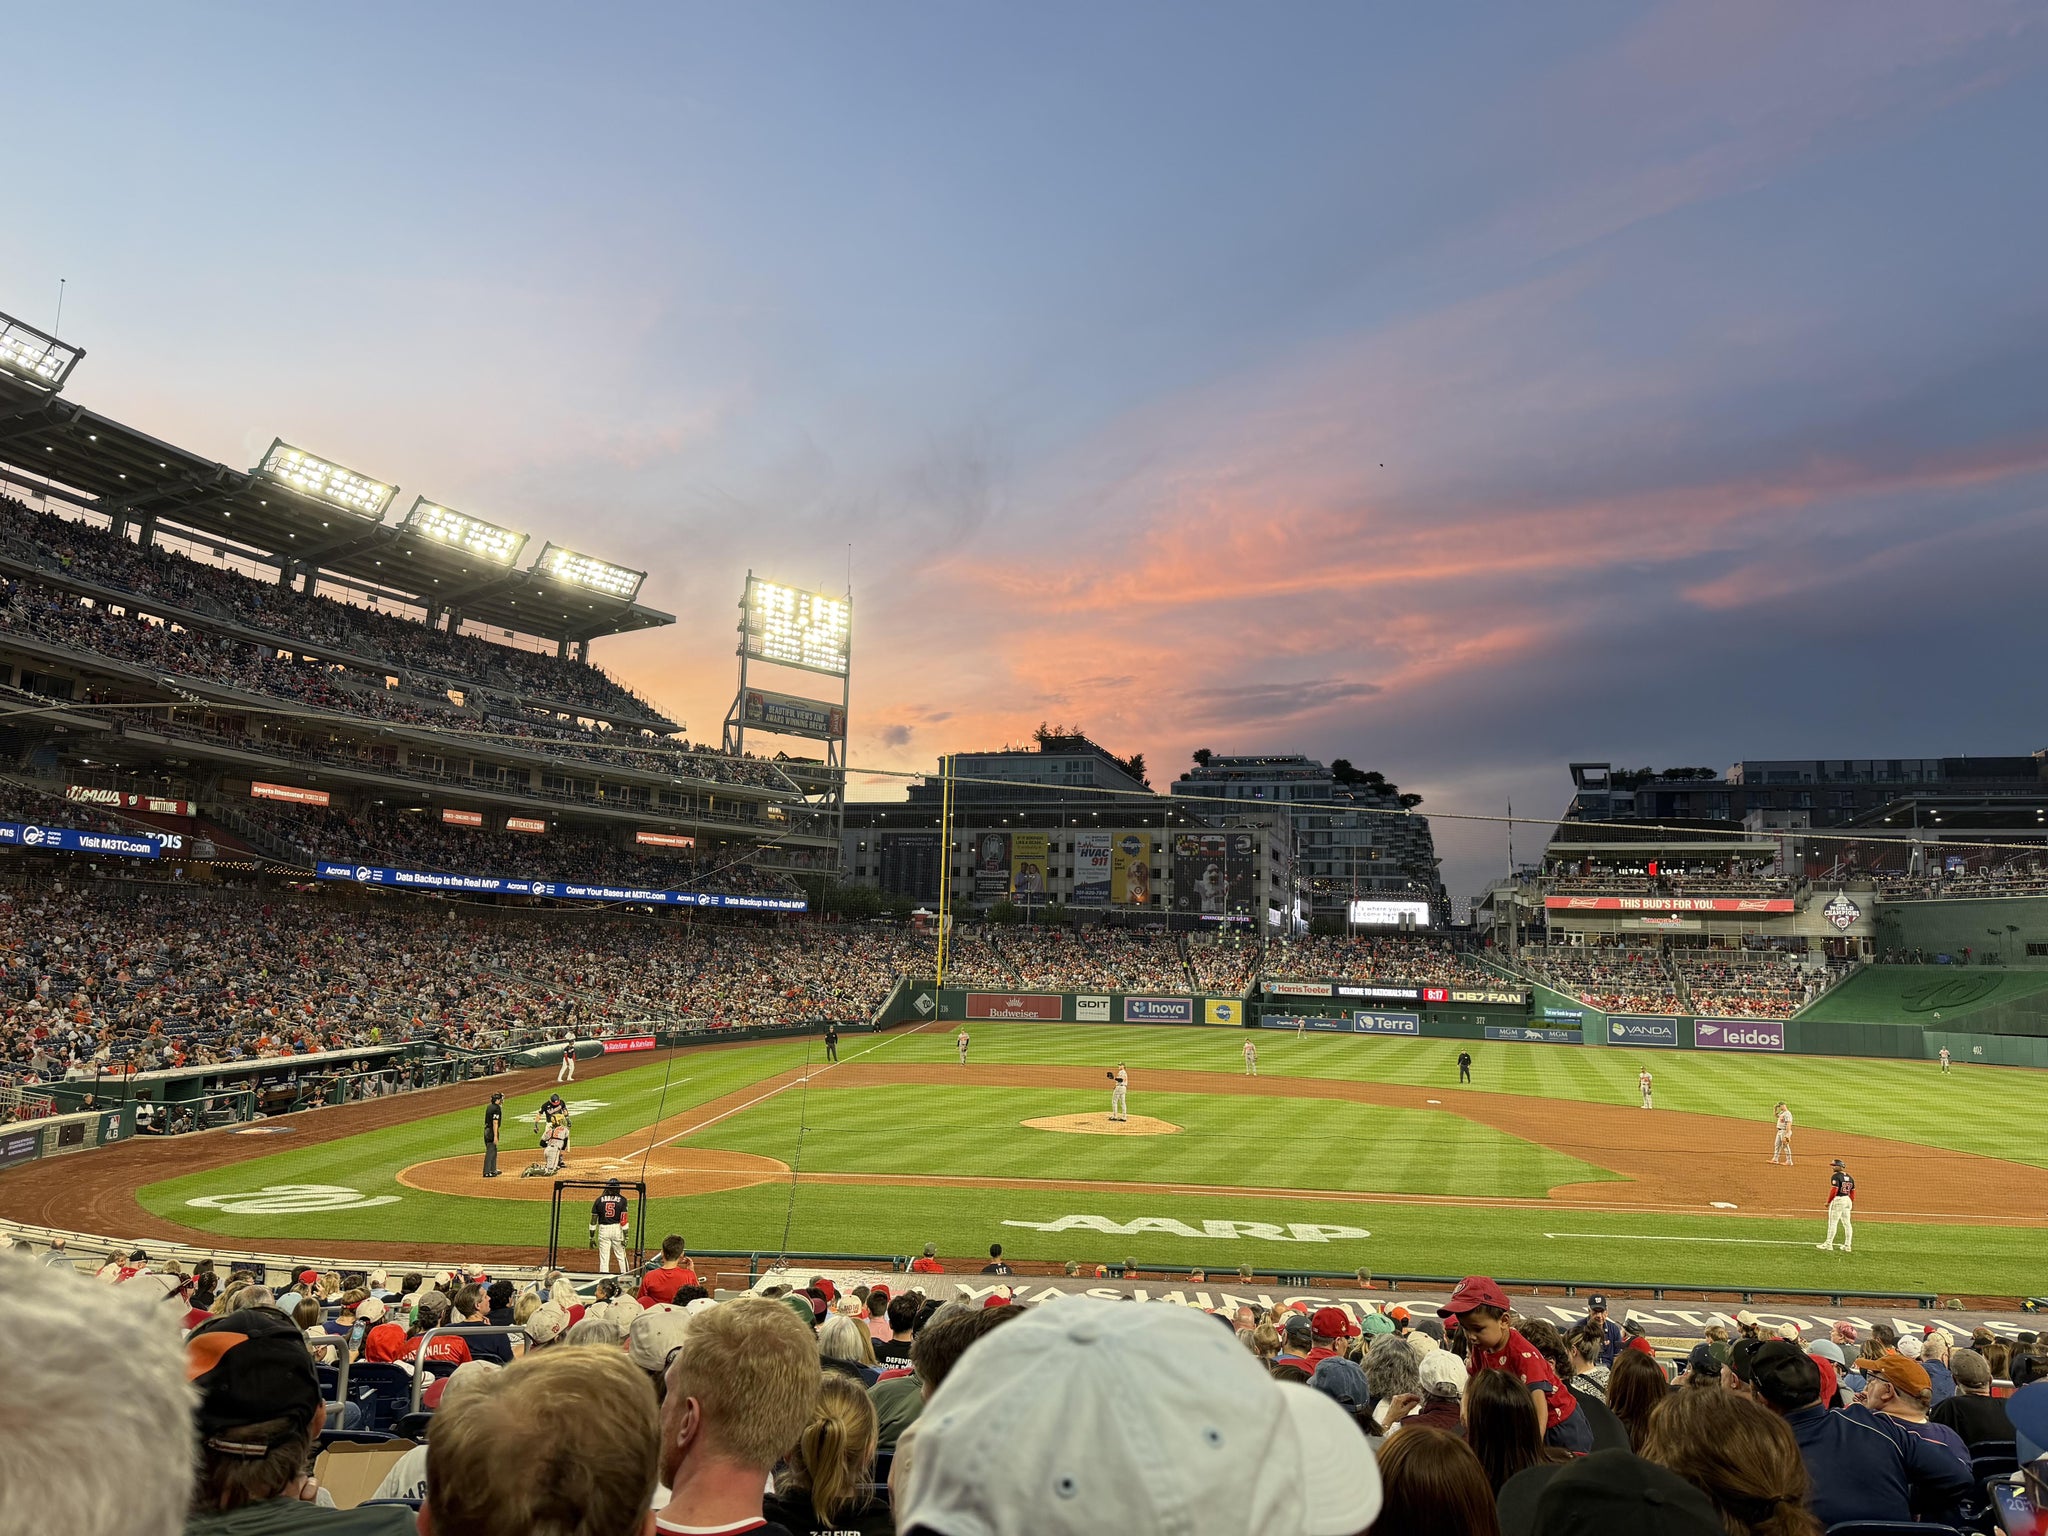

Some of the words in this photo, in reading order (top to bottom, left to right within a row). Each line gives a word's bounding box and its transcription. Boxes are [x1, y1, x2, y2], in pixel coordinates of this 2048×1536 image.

[768, 705, 796, 718] BEAUTIFUL
[796, 709, 813, 720] VIEWS
[814, 714, 825, 723] AND
[766, 713, 785, 724] AWARD
[786, 716, 809, 728] WINNING
[809, 720, 827, 732] BREWS
[150, 800, 177, 813] NATITUDE
[79, 835, 100, 848] Visit
[101, 838, 151, 854] M3TC.com
[1080, 848, 1109, 858] HVAC
[1092, 857, 1108, 866] 911
[326, 866, 350, 876] Acronis
[396, 871, 414, 882] Data
[414, 873, 442, 886] Backup
[451, 877, 462, 886] the
[464, 878, 481, 888] Real
[482, 880, 500, 889] MVP
[506, 882, 528, 890] Acronis
[566, 886, 586, 894] Cover
[587, 888, 602, 896] Your
[603, 889, 624, 898] Bases
[632, 890, 666, 900] M3TC.com
[724, 896, 739, 905] Data
[740, 898, 762, 908] Backup
[768, 900, 778, 908] the
[778, 900, 791, 908] Real
[792, 901, 806, 909] MVP
[1619, 898, 1642, 909] THIS
[1642, 898, 1672, 909] BUD'S
[1672, 898, 1692, 909] FOR
[1694, 899, 1716, 910] YOU.
[1278, 984, 1302, 993] Harris
[1303, 986, 1330, 994] Teeter
[1338, 987, 1364, 995] WELCOME
[1365, 988, 1372, 996] TO
[1372, 988, 1400, 997] NATIONALS
[1401, 990, 1418, 998] PARK
[1428, 990, 1444, 1000] 8:17
[1488, 992, 1521, 1003] FAN
[1078, 1000, 1109, 1008] GDIT
[1148, 1002, 1184, 1014] Inova
[990, 1008, 1039, 1018] Budweiser
[1374, 1017, 1414, 1030] Terra
[1499, 1028, 1518, 1036] MGM
[1625, 1025, 1672, 1035] VANDA
[1723, 1028, 1780, 1046] leidos
[605, 1202, 616, 1218] 5
[1001, 1214, 1371, 1243] AARP
[402, 1344, 451, 1362] ATNALS
